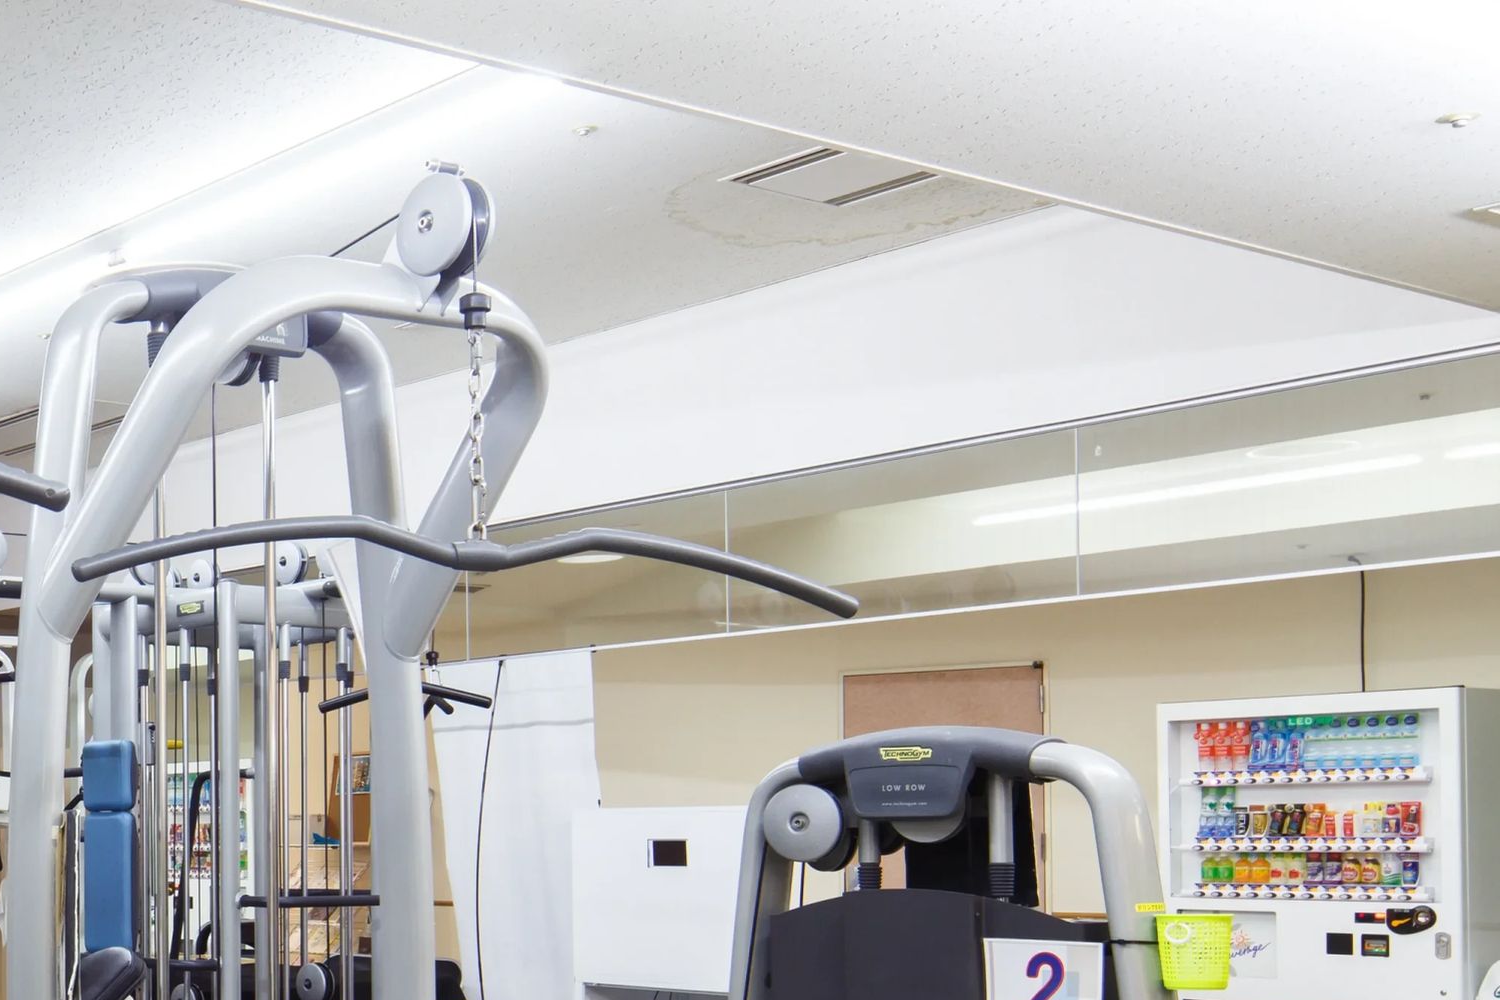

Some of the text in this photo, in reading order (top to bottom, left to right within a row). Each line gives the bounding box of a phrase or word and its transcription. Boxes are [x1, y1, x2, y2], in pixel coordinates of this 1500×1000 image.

[1288, 717, 1313, 726] LED
[882, 784, 927, 792] LOW ROW
